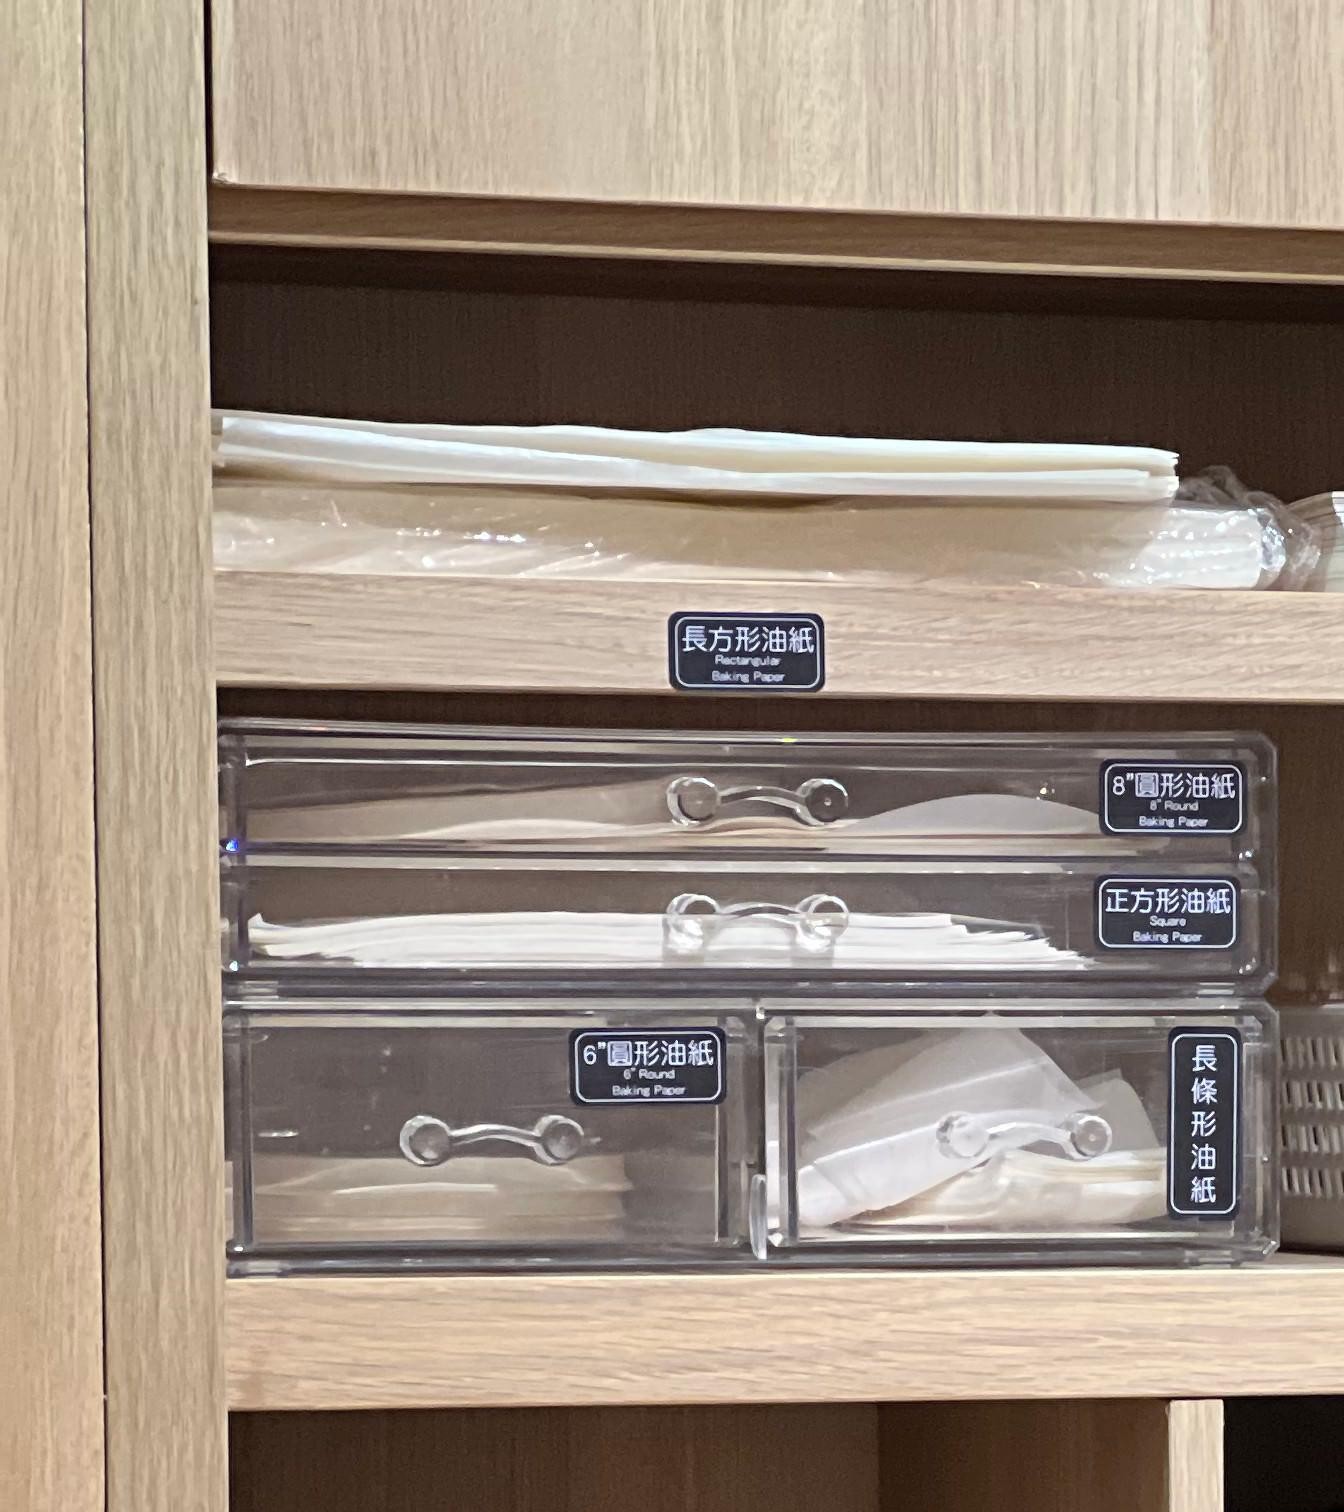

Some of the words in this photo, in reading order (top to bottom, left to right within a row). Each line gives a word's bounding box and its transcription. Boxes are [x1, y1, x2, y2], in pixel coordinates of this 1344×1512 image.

[682, 625, 814, 653] 長方形油紙
[715, 654, 781, 667] Rectangular
[712, 671, 750, 683] Baking
[753, 671, 785, 683] Paper
[1164, 801, 1198, 811] Round
[1139, 816, 1174, 828] Baking
[1178, 816, 1208, 827] Paper
[1105, 888, 1231, 914] 正方形油紙
[1150, 915, 1186, 927] Square
[1133, 931, 1169, 943] Baking
[1172, 931, 1202, 942] Paper
[639, 1069, 675, 1080] Round
[612, 1085, 650, 1097] Baking
[654, 1085, 686, 1096] Paper
[1190, 1044, 1218, 1204] 長條形油紙
